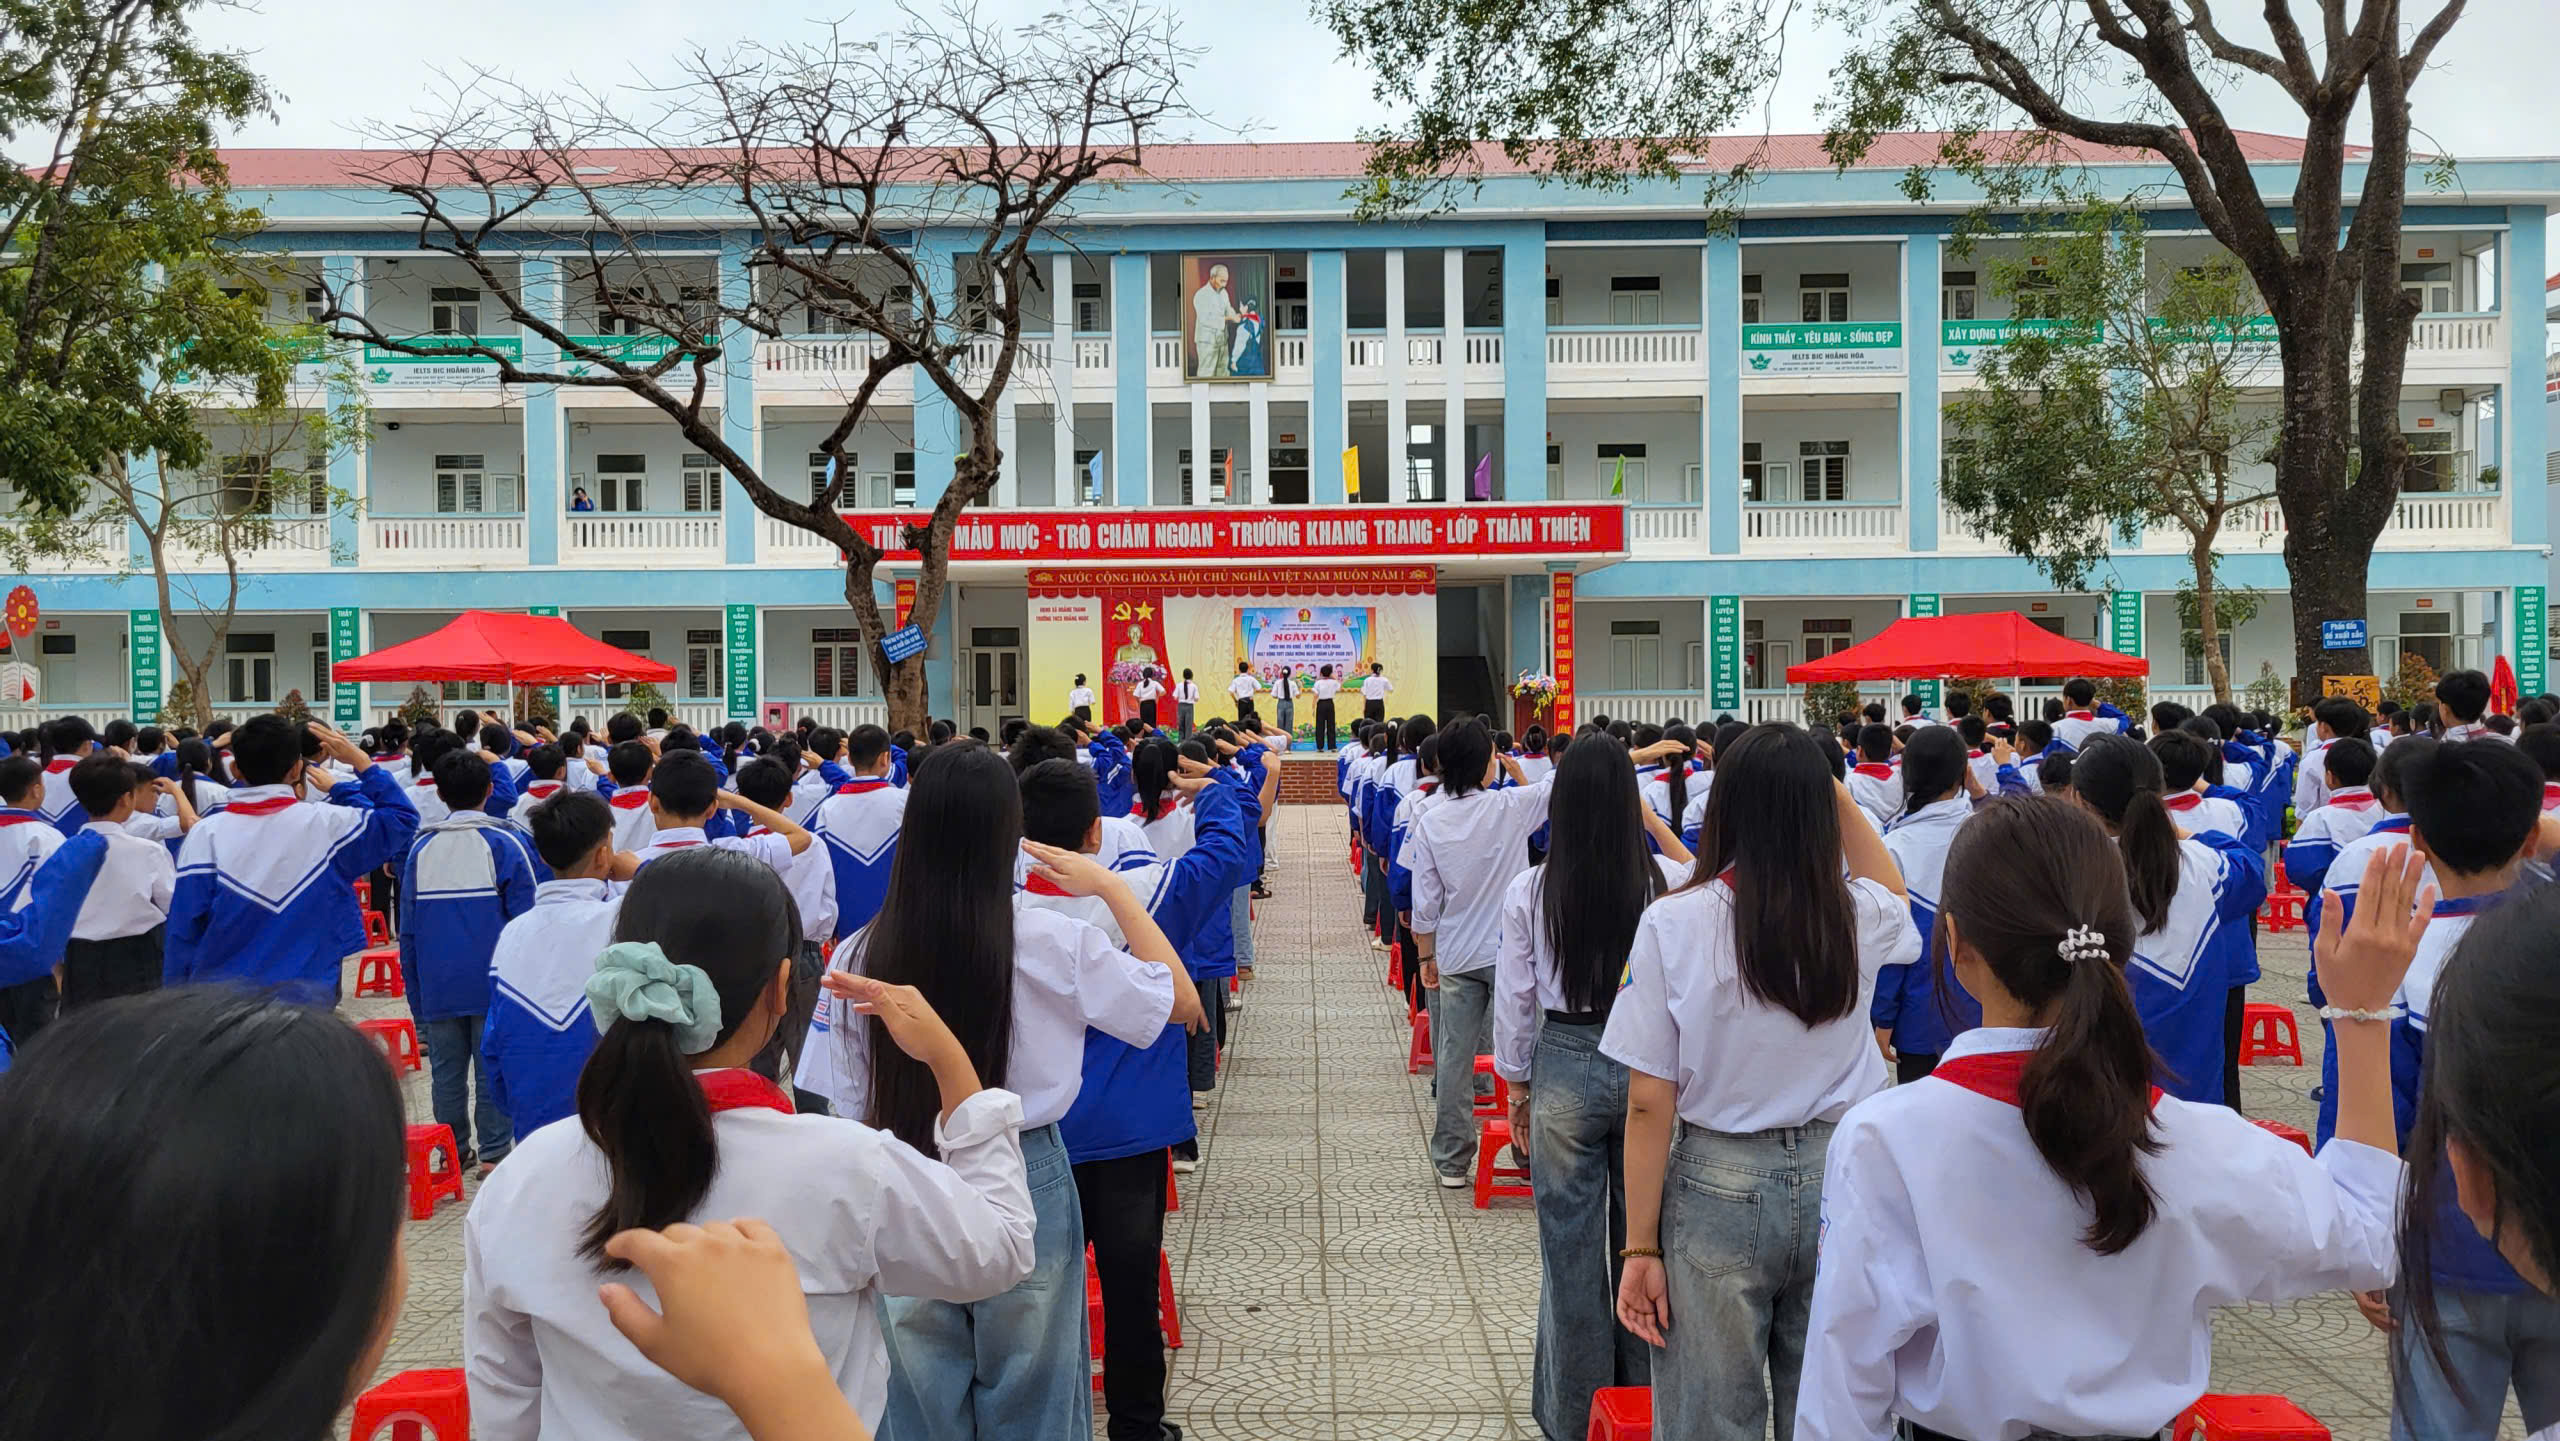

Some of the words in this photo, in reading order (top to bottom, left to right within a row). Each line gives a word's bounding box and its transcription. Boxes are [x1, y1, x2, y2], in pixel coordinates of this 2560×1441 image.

[1751, 331, 1772, 344] KÍNH
[1804, 330, 1822, 343] YÊU
[1823, 331, 1841, 345] BẠN
[1850, 328, 1873, 343] SỐNG
[1876, 330, 1893, 344] ĐẸP
[1948, 326, 1966, 340] XÂY
[1969, 327, 1996, 342] DỰNG
[954, 517, 993, 550] MẪU
[1000, 521, 1039, 555] MỰC
[1056, 518, 1091, 550] TRÒ
[1097, 519, 1150, 549] CHĂM
[1155, 522, 1213, 548] NGOAN
[1229, 515, 1299, 547] TRƯỜNG
[1306, 519, 1367, 546] KHANG
[1374, 518, 1433, 545] TRANG
[1447, 512, 1478, 544] LỚP
[1486, 513, 1532, 543] THÂN
[1540, 512, 1590, 546] THIỆN
[1059, 572, 1092, 583] NƯỚC
[1096, 571, 1129, 585] CỘNG
[1132, 570, 1157, 583] HÒA
[1160, 571, 1176, 582] XÃ
[1178, 571, 1200, 584] HỘI
[1203, 569, 1228, 582] CHỦ
[1232, 569, 1271, 582] NGHĨA
[1273, 569, 1300, 583] VIỆT
[1304, 571, 1329, 581] NAM
[1333, 568, 1369, 581] MUÔN
[1371, 568, 1398, 580] NĂM
[2331, 622, 2345, 630] Phấn
[1273, 632, 1309, 641] NGÀY
[1311, 632, 1337, 642] HỘI
[2335, 630, 2350, 639] xuất
[340, 708, 353, 716] CAO
